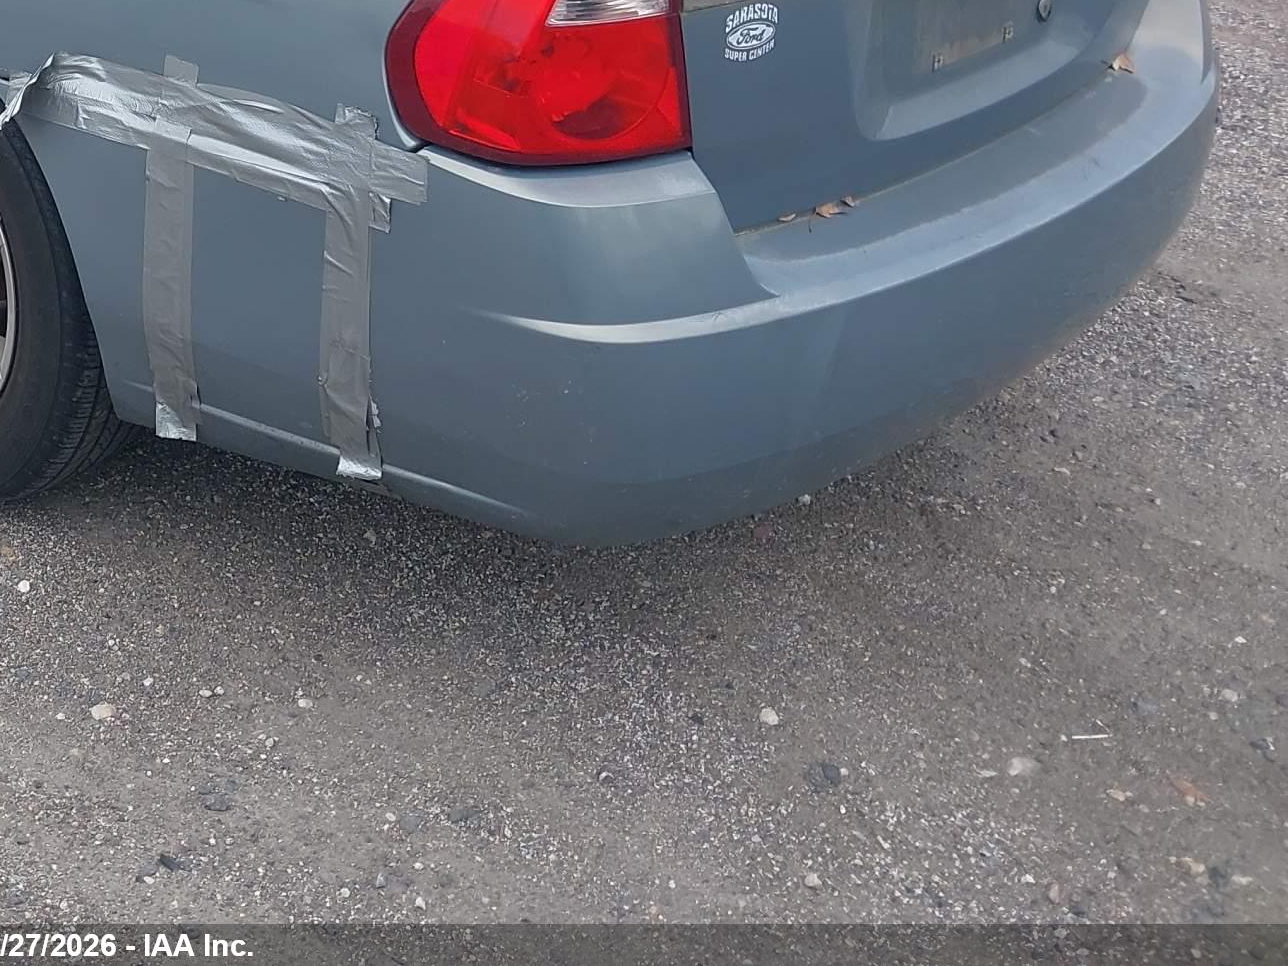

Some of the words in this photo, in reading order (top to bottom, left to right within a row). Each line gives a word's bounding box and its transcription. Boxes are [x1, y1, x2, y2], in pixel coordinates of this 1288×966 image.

[725, 2, 778, 34] SARASOTA
[736, 27, 766, 45] Ford
[724, 48, 747, 62] SUPER
[749, 38, 775, 60] CENTER
